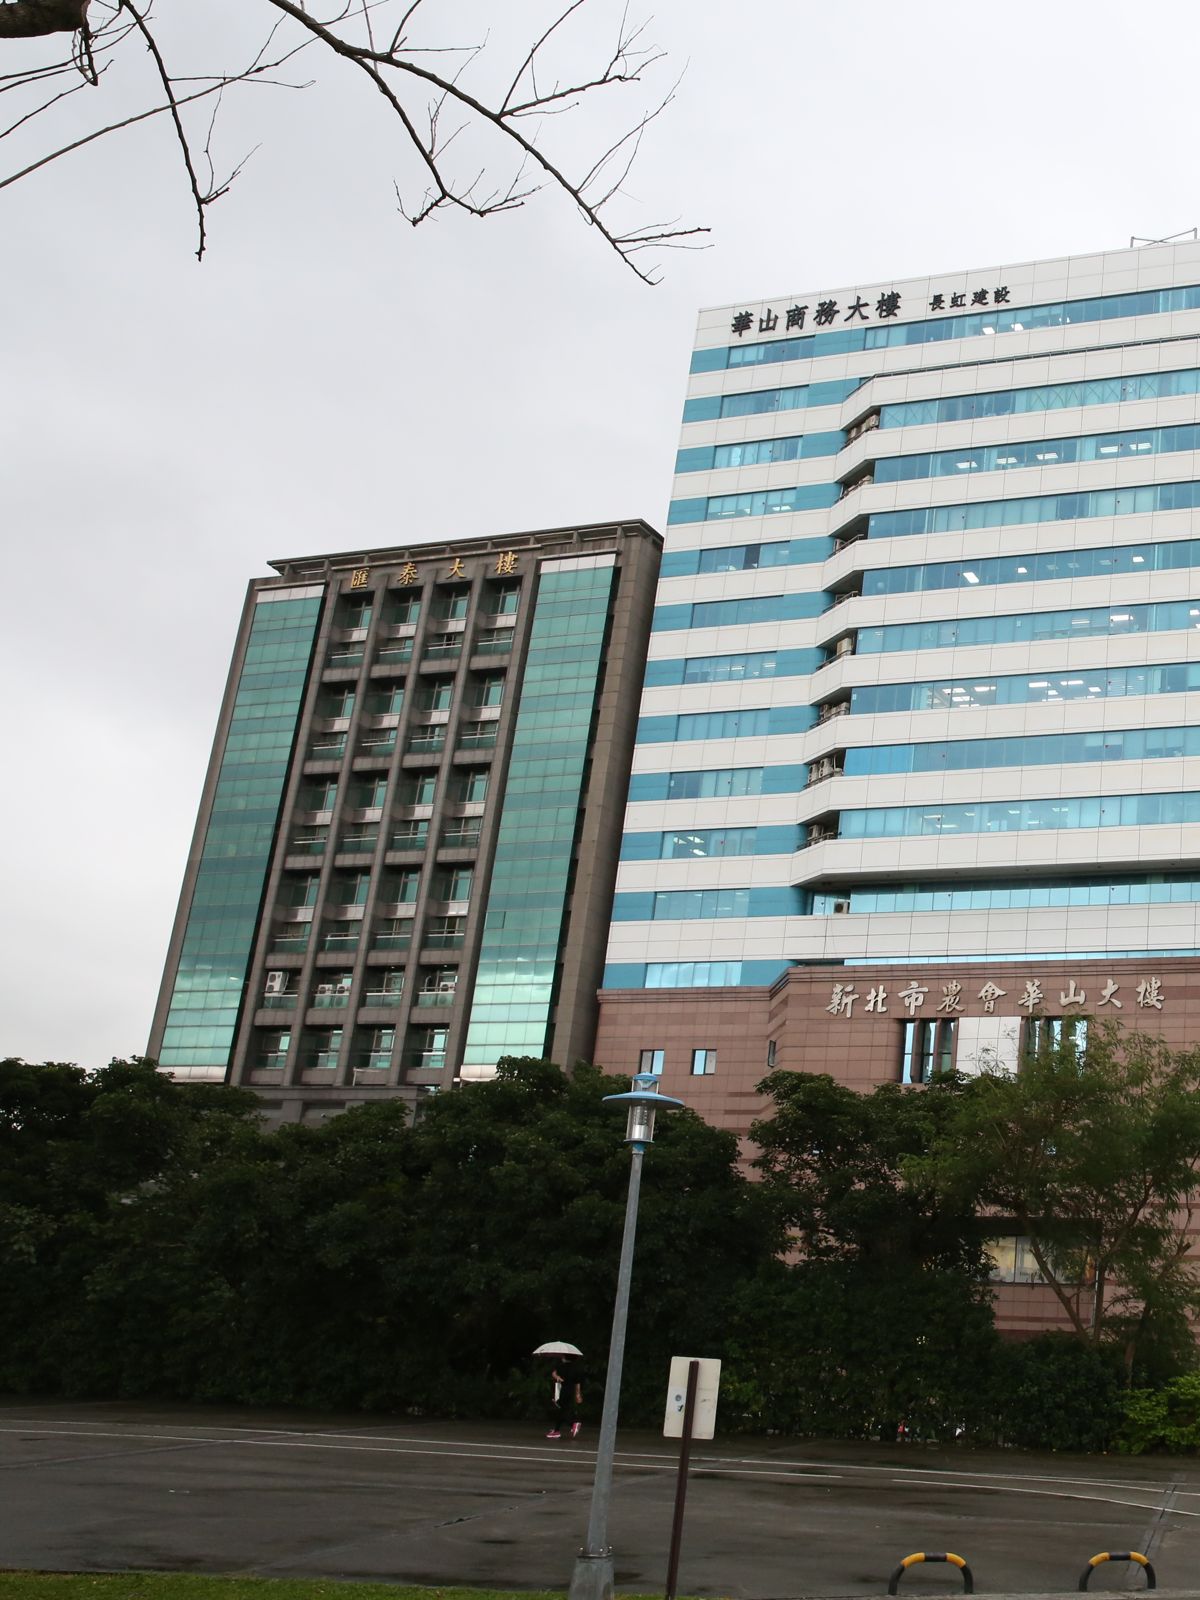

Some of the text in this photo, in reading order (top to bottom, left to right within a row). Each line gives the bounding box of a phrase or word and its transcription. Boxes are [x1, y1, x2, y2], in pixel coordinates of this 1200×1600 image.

[731, 292, 902, 337] 華山商務大樓
[929, 286, 1011, 311] 長虹建設
[351, 551, 518, 589] 匯泰大樓
[825, 976, 1166, 1018] 新北市農會華山大樓
